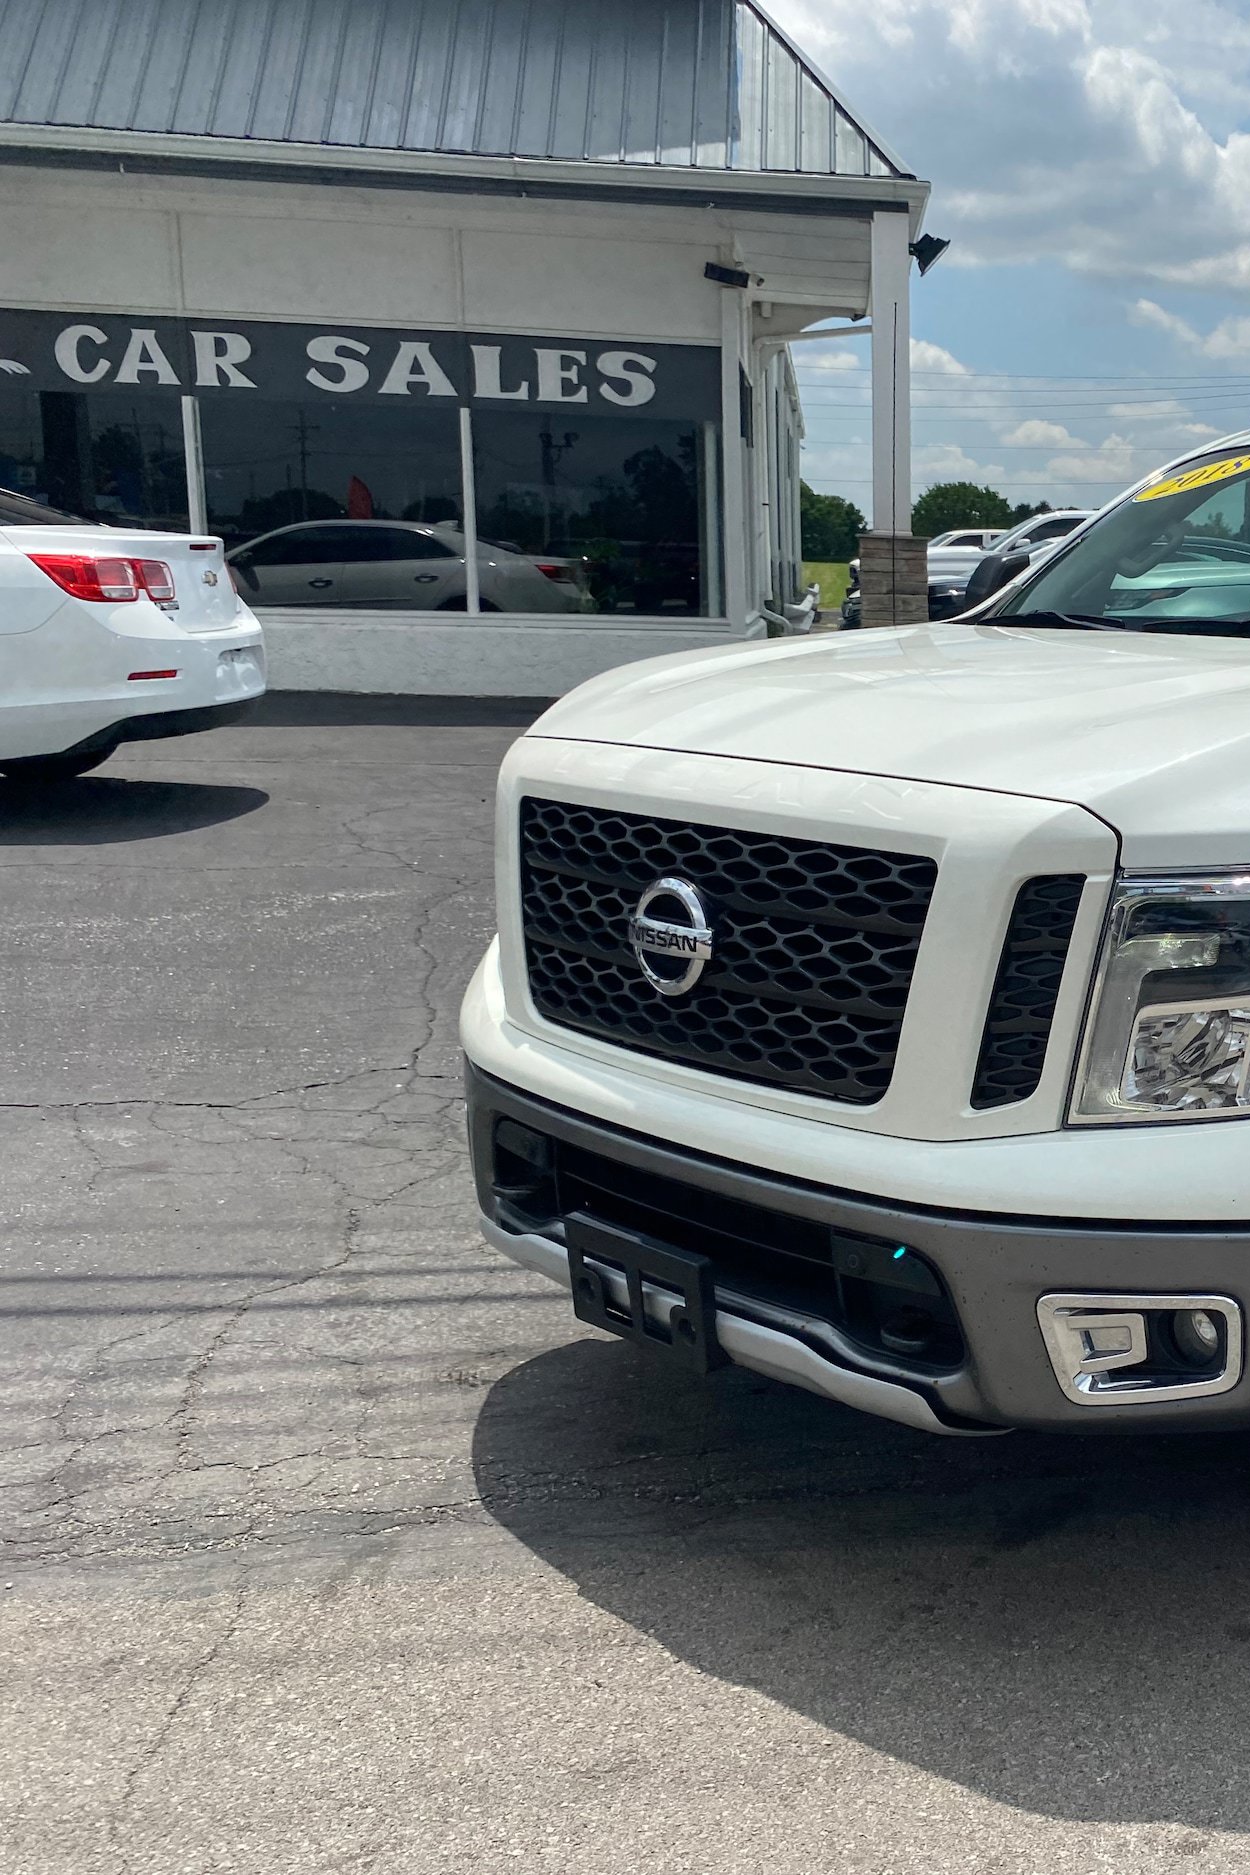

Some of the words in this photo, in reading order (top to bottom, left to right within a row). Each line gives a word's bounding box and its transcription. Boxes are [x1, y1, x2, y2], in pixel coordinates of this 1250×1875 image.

[54, 324, 258, 389] CAR
[304, 335, 658, 407] SALES
[631, 925, 697, 953] NISSAN
